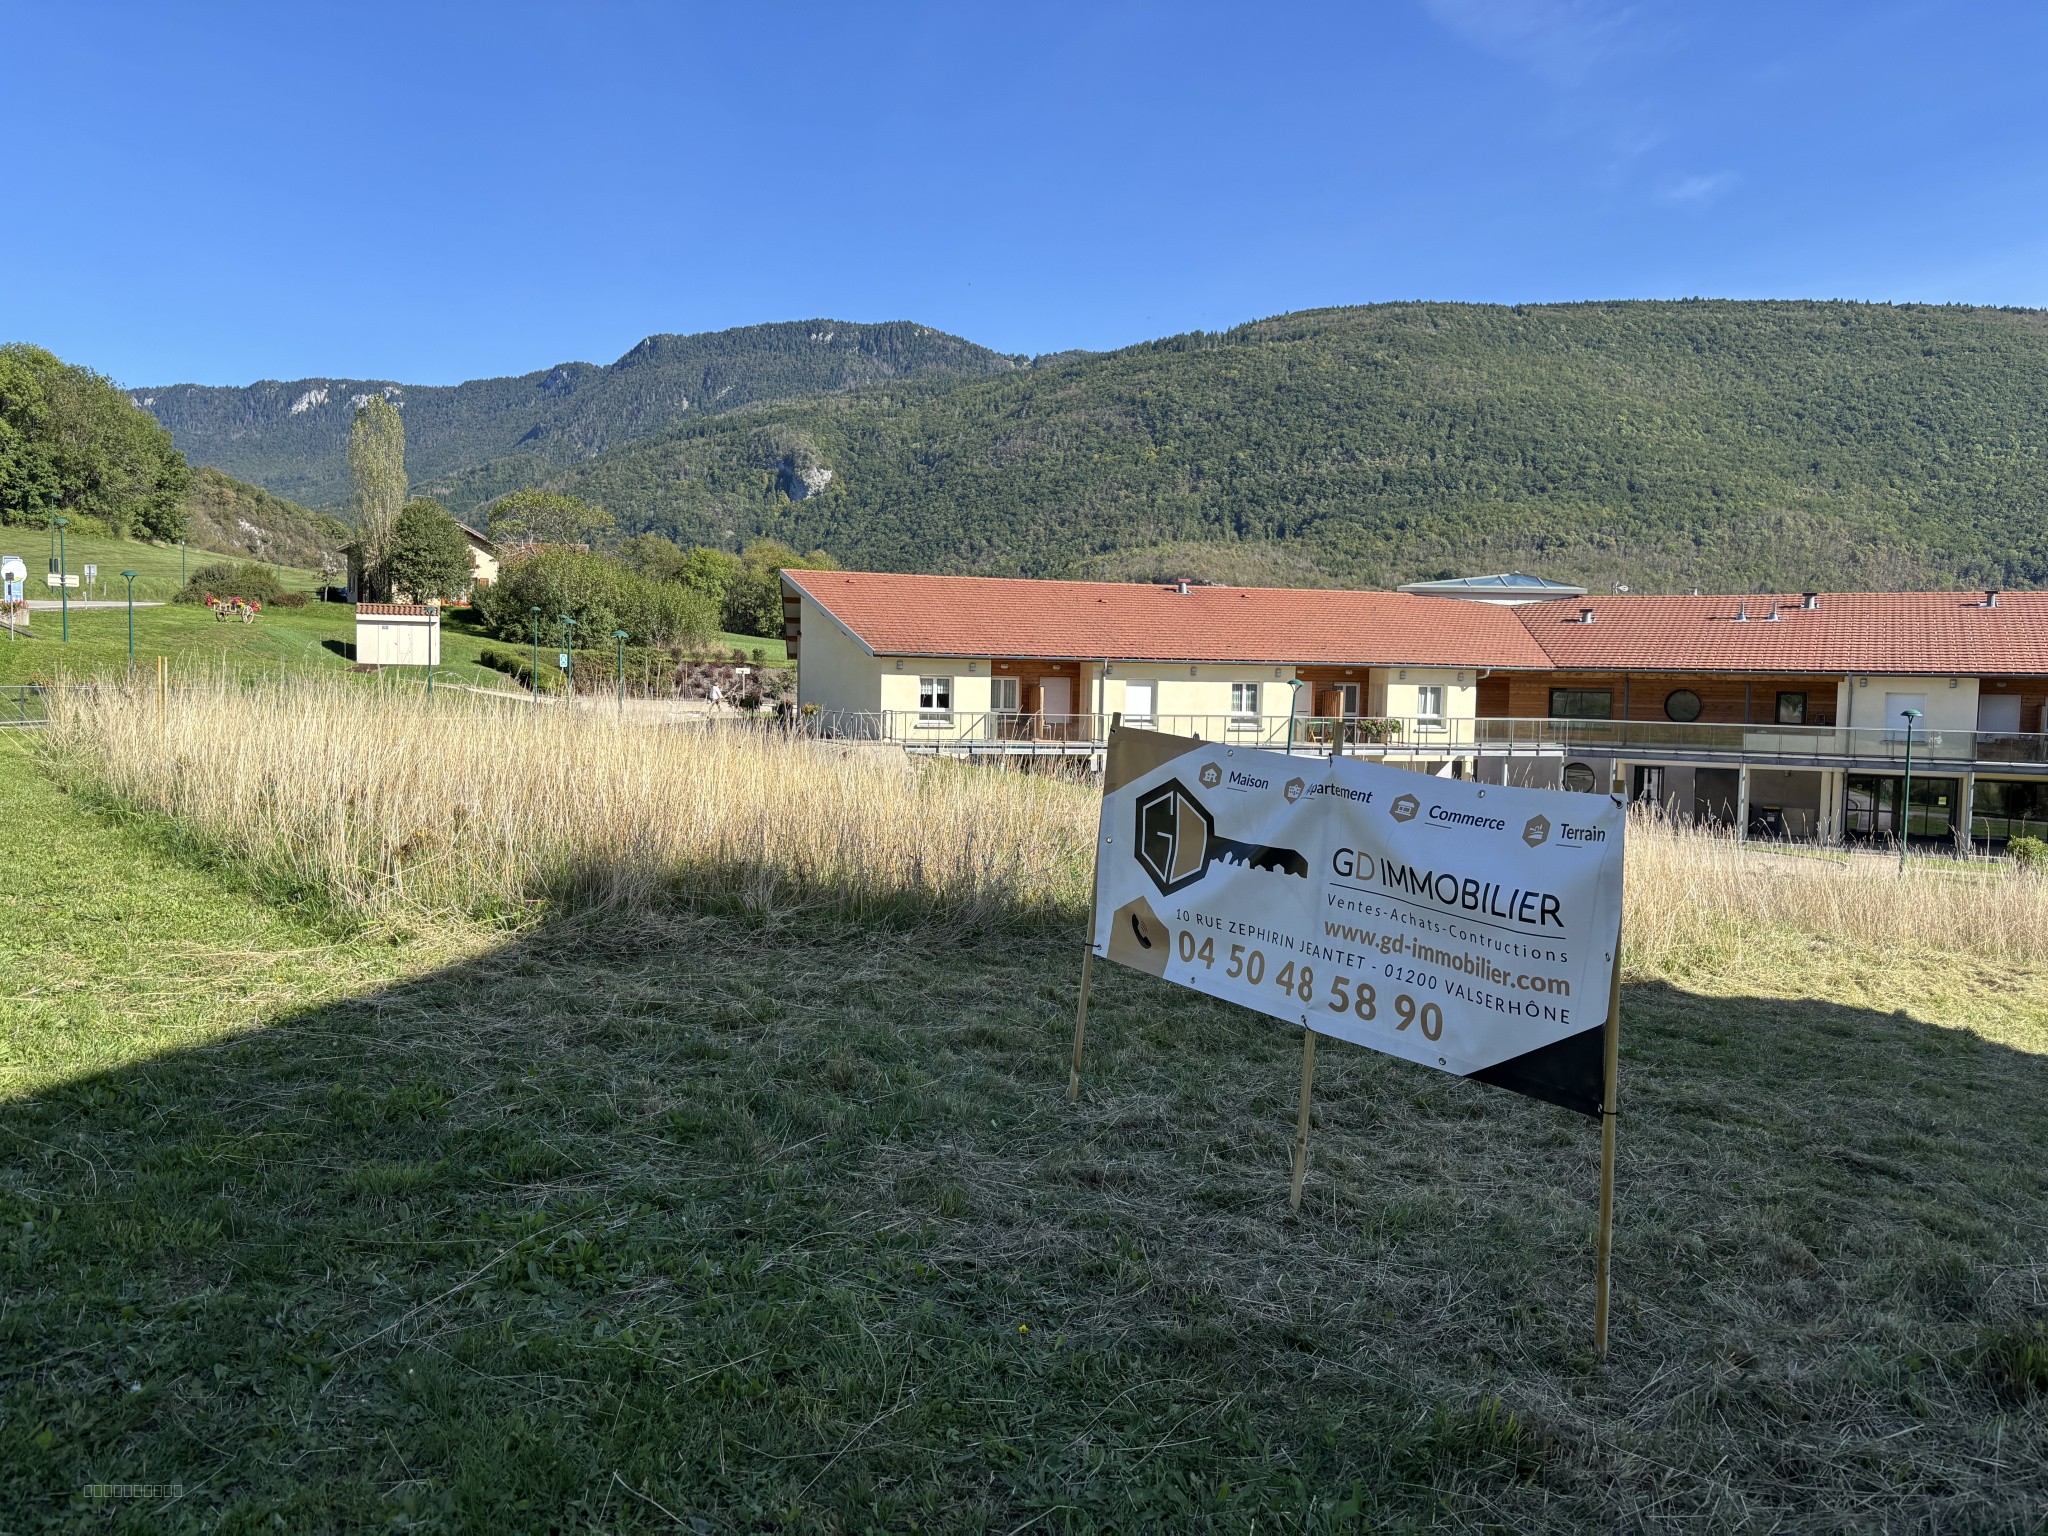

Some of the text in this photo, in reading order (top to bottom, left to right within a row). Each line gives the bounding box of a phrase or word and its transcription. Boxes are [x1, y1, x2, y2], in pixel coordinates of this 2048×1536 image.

[1228, 771, 1269, 790] Maison
[1428, 805, 1505, 831] Commerce
[1560, 823, 1606, 842] Terrain
[1324, 920, 1570, 997] www.gd-immobilier.com
[1327, 893, 1568, 963] Ventes-Achats-Contructions
[1175, 908, 1191, 923] 10
[1196, 913, 1223, 930] RUE
[1228, 921, 1295, 950] ZEPHIRIN
[1299, 941, 1366, 970] JEANTET
[1384, 963, 1438, 990] 01200
[1444, 979, 1570, 1025] VALSERHÔNE
[1178, 930, 1444, 1042] 04 50 48 58 90
